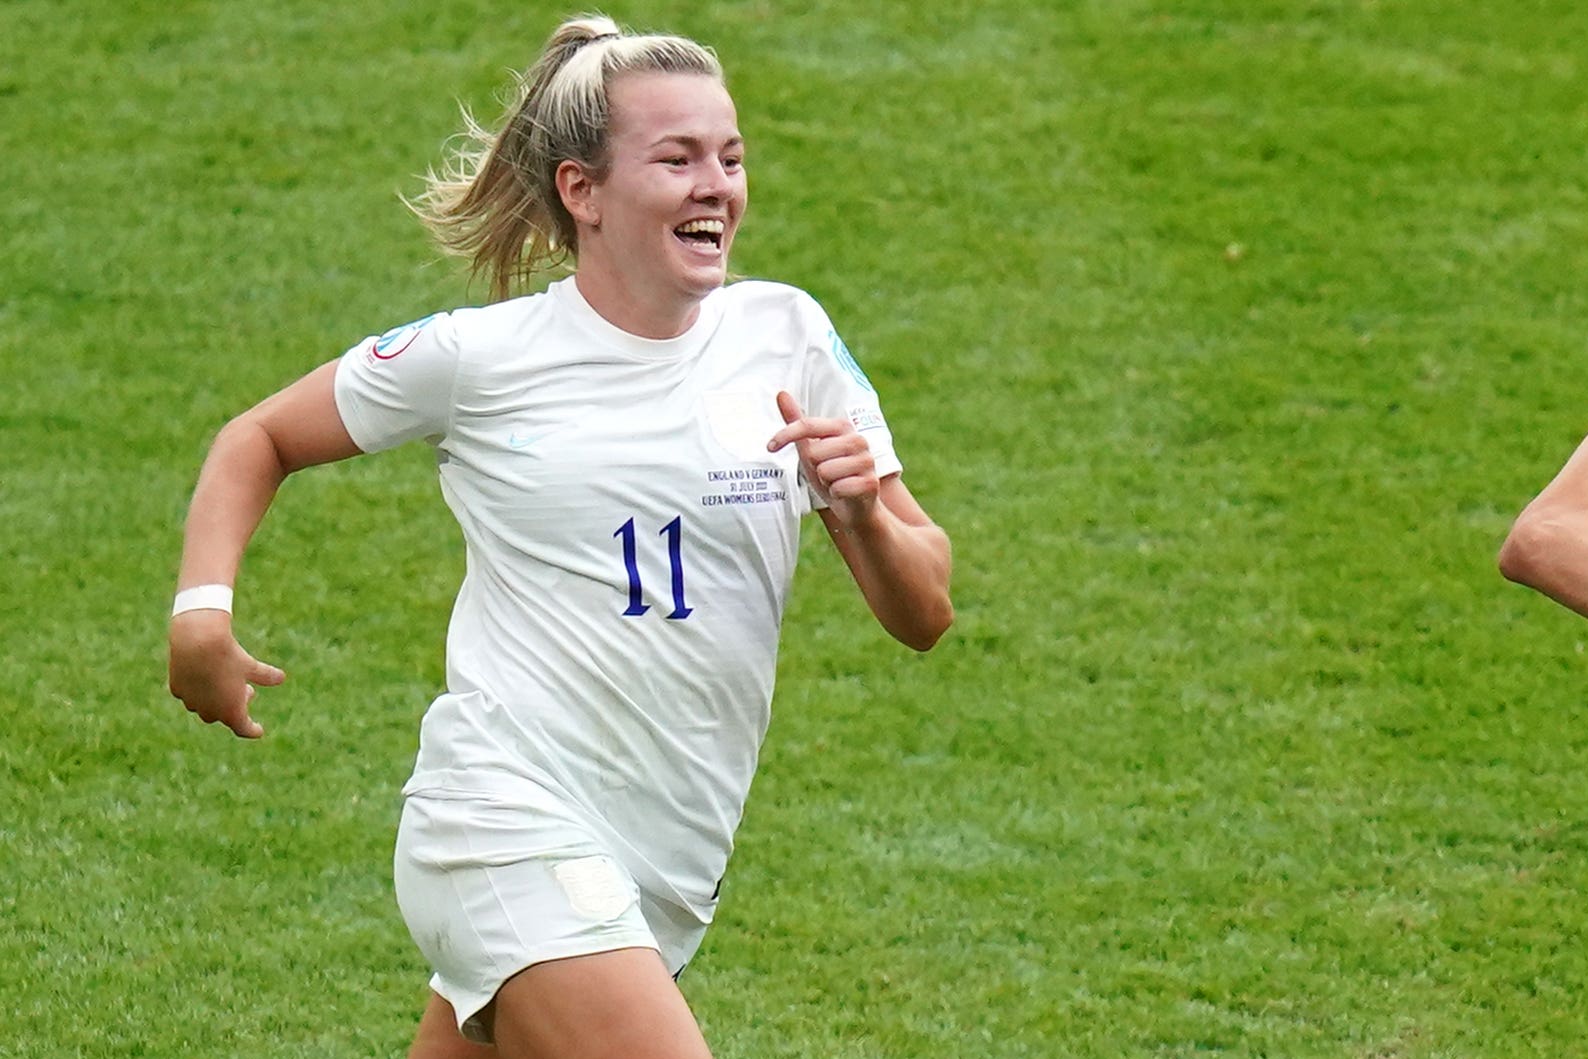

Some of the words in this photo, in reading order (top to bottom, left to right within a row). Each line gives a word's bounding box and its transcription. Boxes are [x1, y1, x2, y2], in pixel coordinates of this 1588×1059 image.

[708, 470, 745, 481] ENGLAND
[702, 495, 723, 506] UEFA
[613, 515, 694, 619] 11
